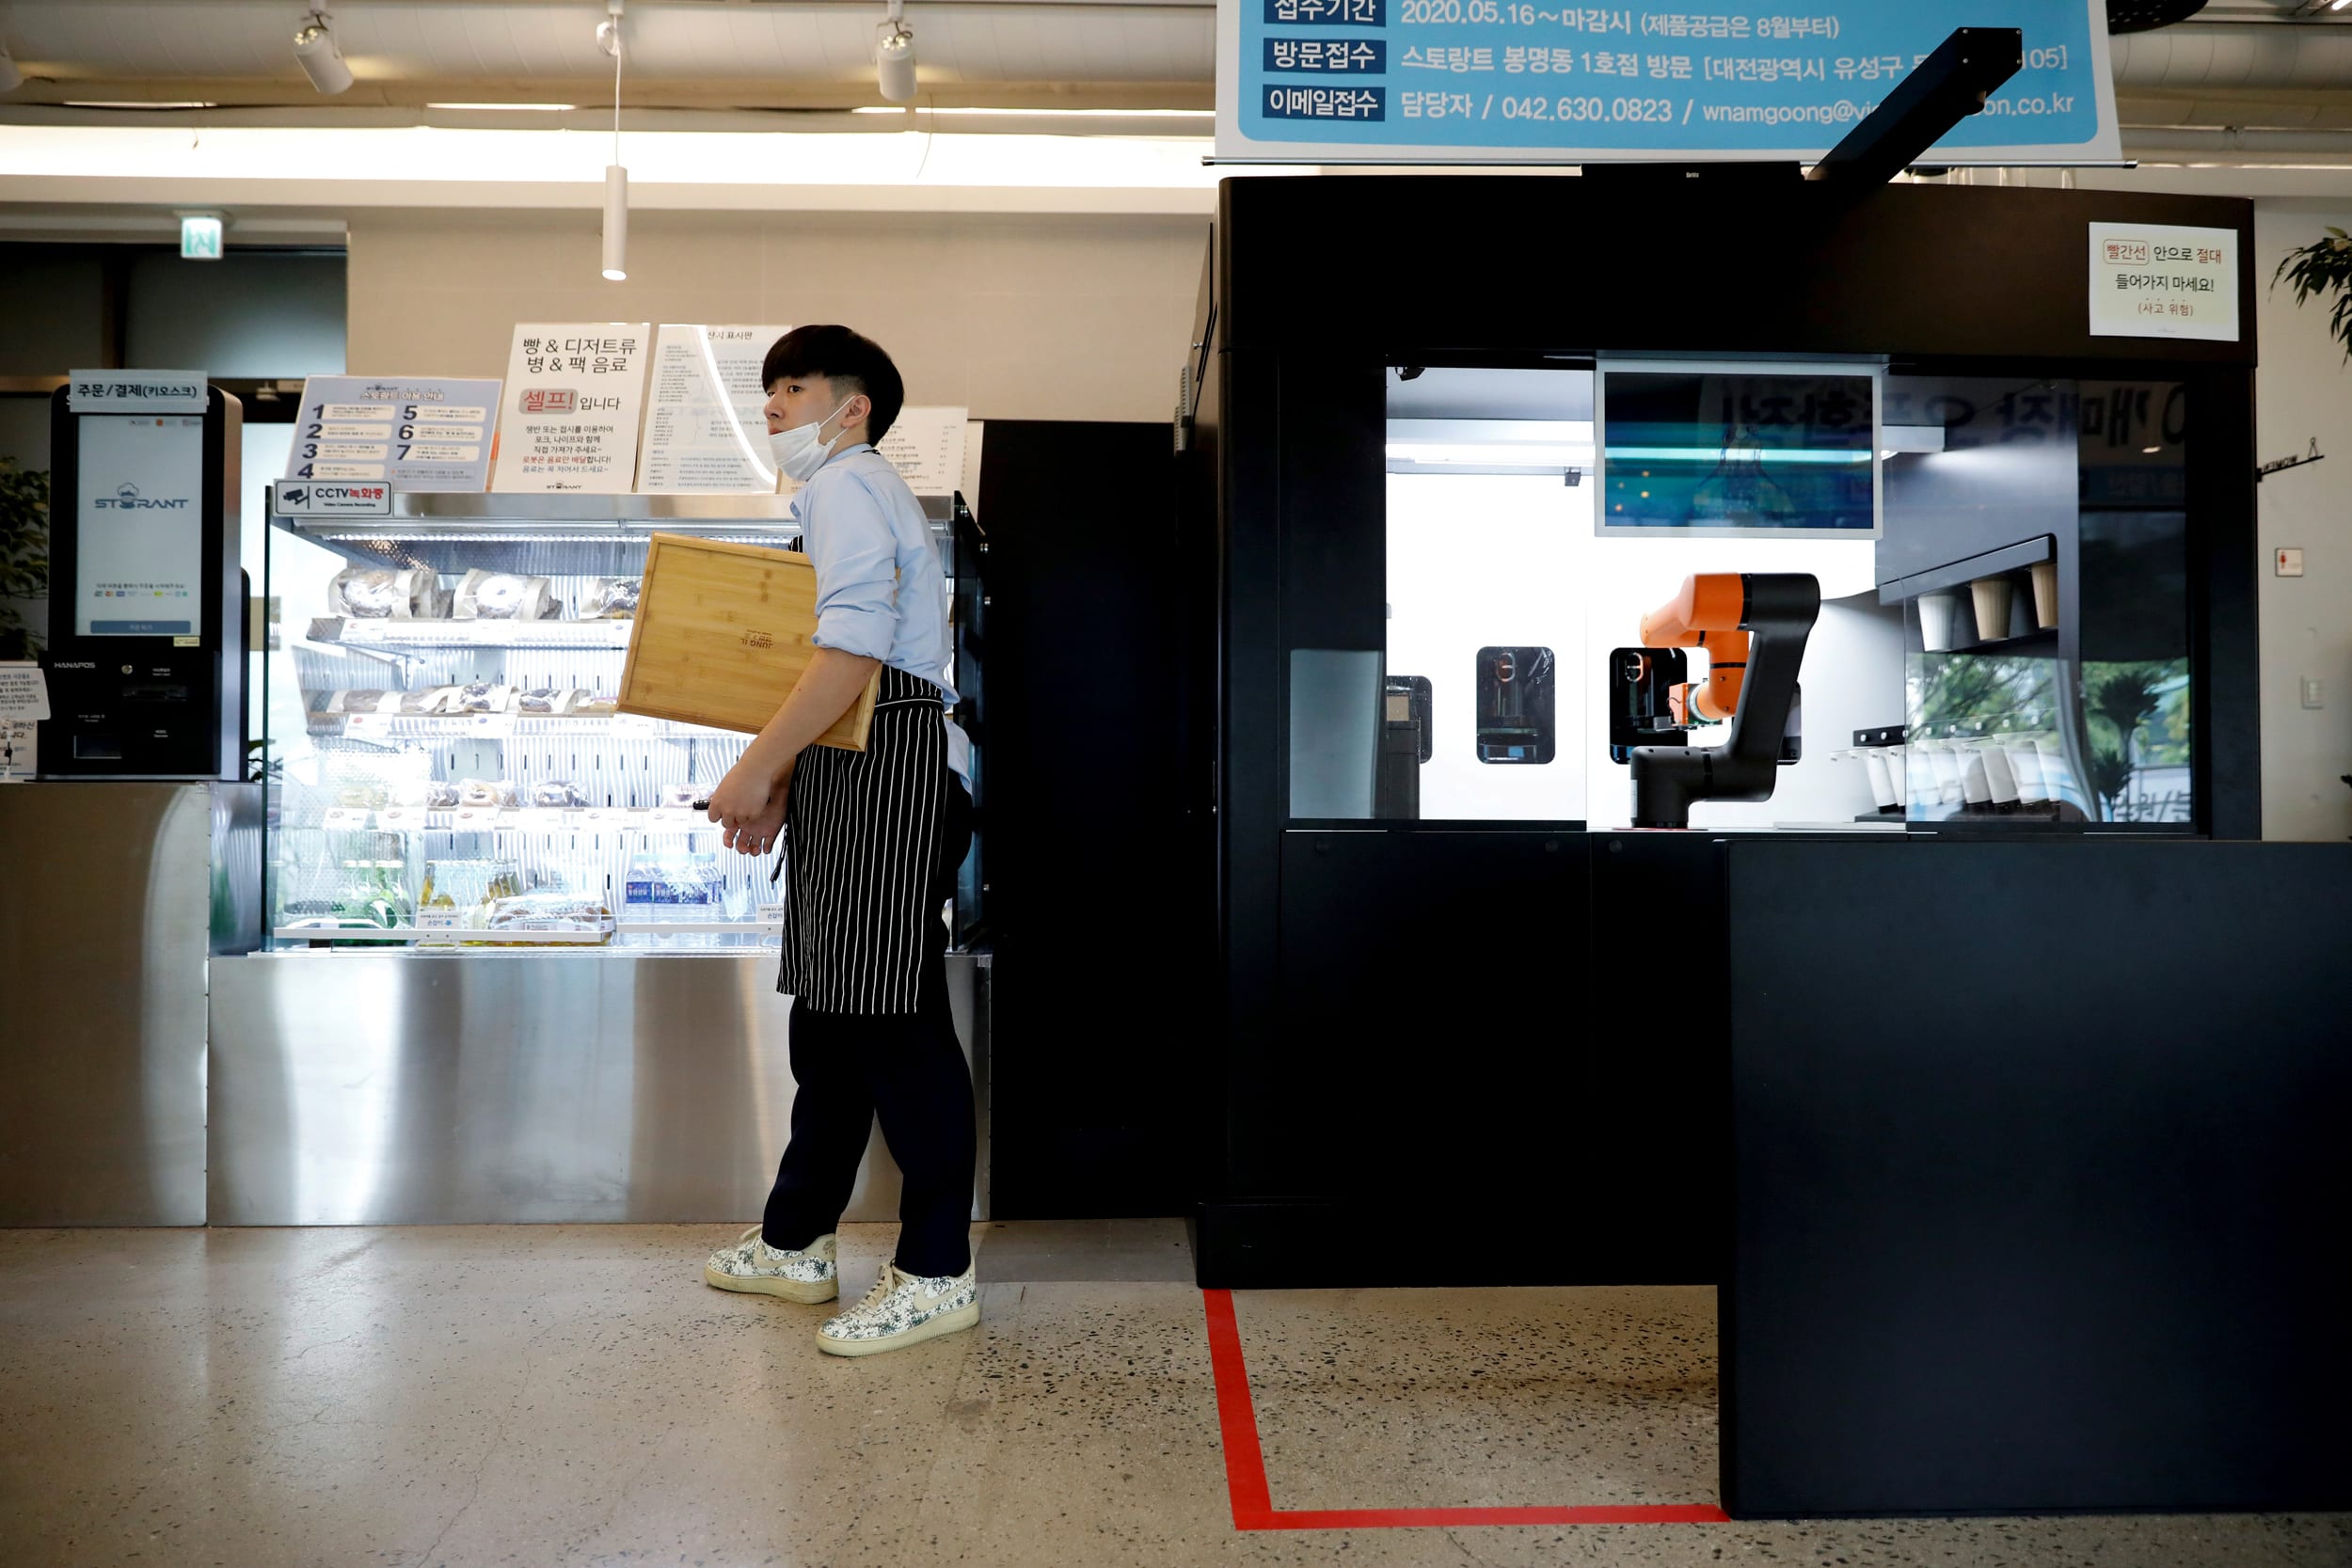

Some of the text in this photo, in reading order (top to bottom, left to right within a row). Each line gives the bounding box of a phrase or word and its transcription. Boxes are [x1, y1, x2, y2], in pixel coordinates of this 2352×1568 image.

[1274, 0, 1376, 24] 접수기간
[1640, 13, 1751, 39] (제품공급은
[1756, 15, 1840, 39] 8월부터)
[1273, 41, 1376, 71] 방문접수
[1401, 46, 1495, 72] 스토랑트
[1502, 48, 1573, 75] 봉명동
[1581, 51, 1640, 77] 1호점
[1647, 54, 1692, 80] 방문
[1704, 55, 1825, 84] [대전광역시
[1834, 55, 1904, 83] 유성구
[1269, 88, 1378, 119] 이메일접수
[1401, 92, 1473, 120] 담당자
[1481, 94, 1493, 119] /
[1502, 96, 1672, 123] 042.630.0823
[1681, 100, 1694, 124] /
[2106, 244, 2221, 264] 빨간선 안으로 절대
[2115, 273, 2214, 293] 들어가지 마세요!
[2137, 302, 2194, 317] (사고 위험)
[523, 338, 637, 356] 빵 & 디저트류
[527, 356, 628, 374] 병 & 팩 음료
[77, 384, 198, 399] 주문/결제(키오스크)
[523, 390, 621, 412] 셀프! 입니다
[312, 404, 325, 420] 1
[403, 404, 418, 420] 5
[306, 423, 324, 439] 2
[398, 424, 415, 440] 6
[542, 425, 557, 434] 또는
[583, 425, 613, 434] 이용하여
[553, 436, 584, 444] 나이프와
[586, 436, 600, 444] 함께
[302, 443, 319, 459] 3
[397, 444, 411, 460] 7
[297, 463, 314, 479] 4
[94, 491, 188, 509] STORANT
[315, 487, 384, 499] CCTV녹화중
